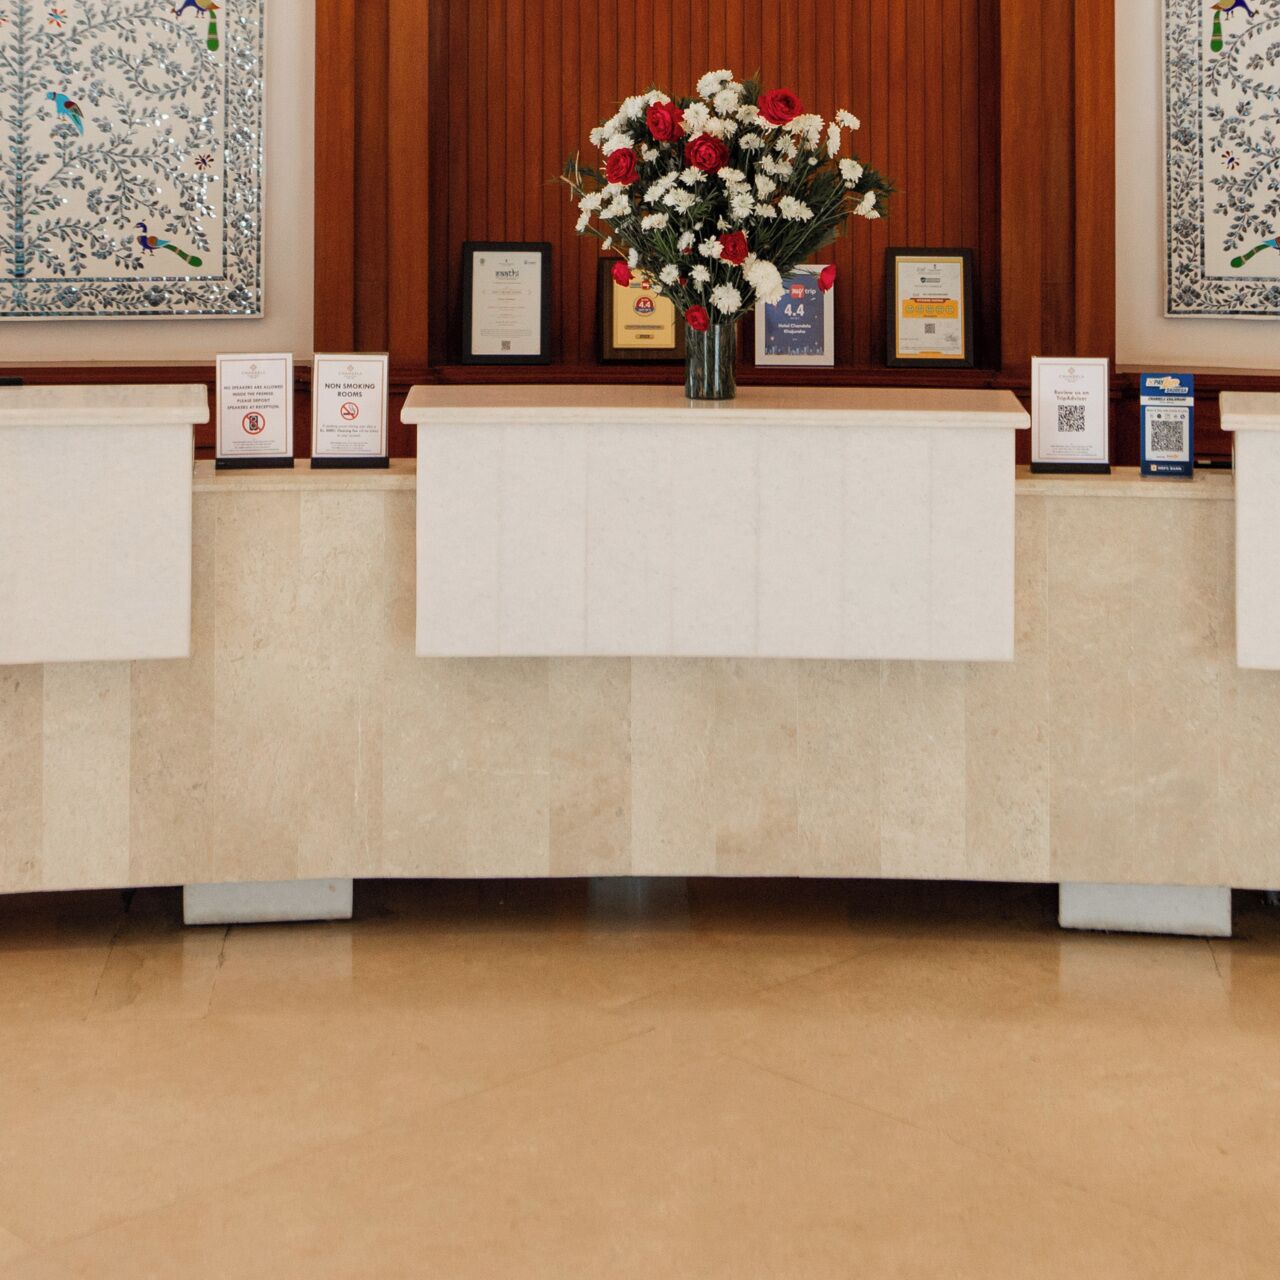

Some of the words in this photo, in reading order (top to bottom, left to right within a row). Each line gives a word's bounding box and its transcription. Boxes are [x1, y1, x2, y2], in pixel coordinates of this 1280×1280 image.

[804, 287, 817, 296] trip
[638, 301, 651, 309] 4.4
[784, 304, 805, 317] 4.4
